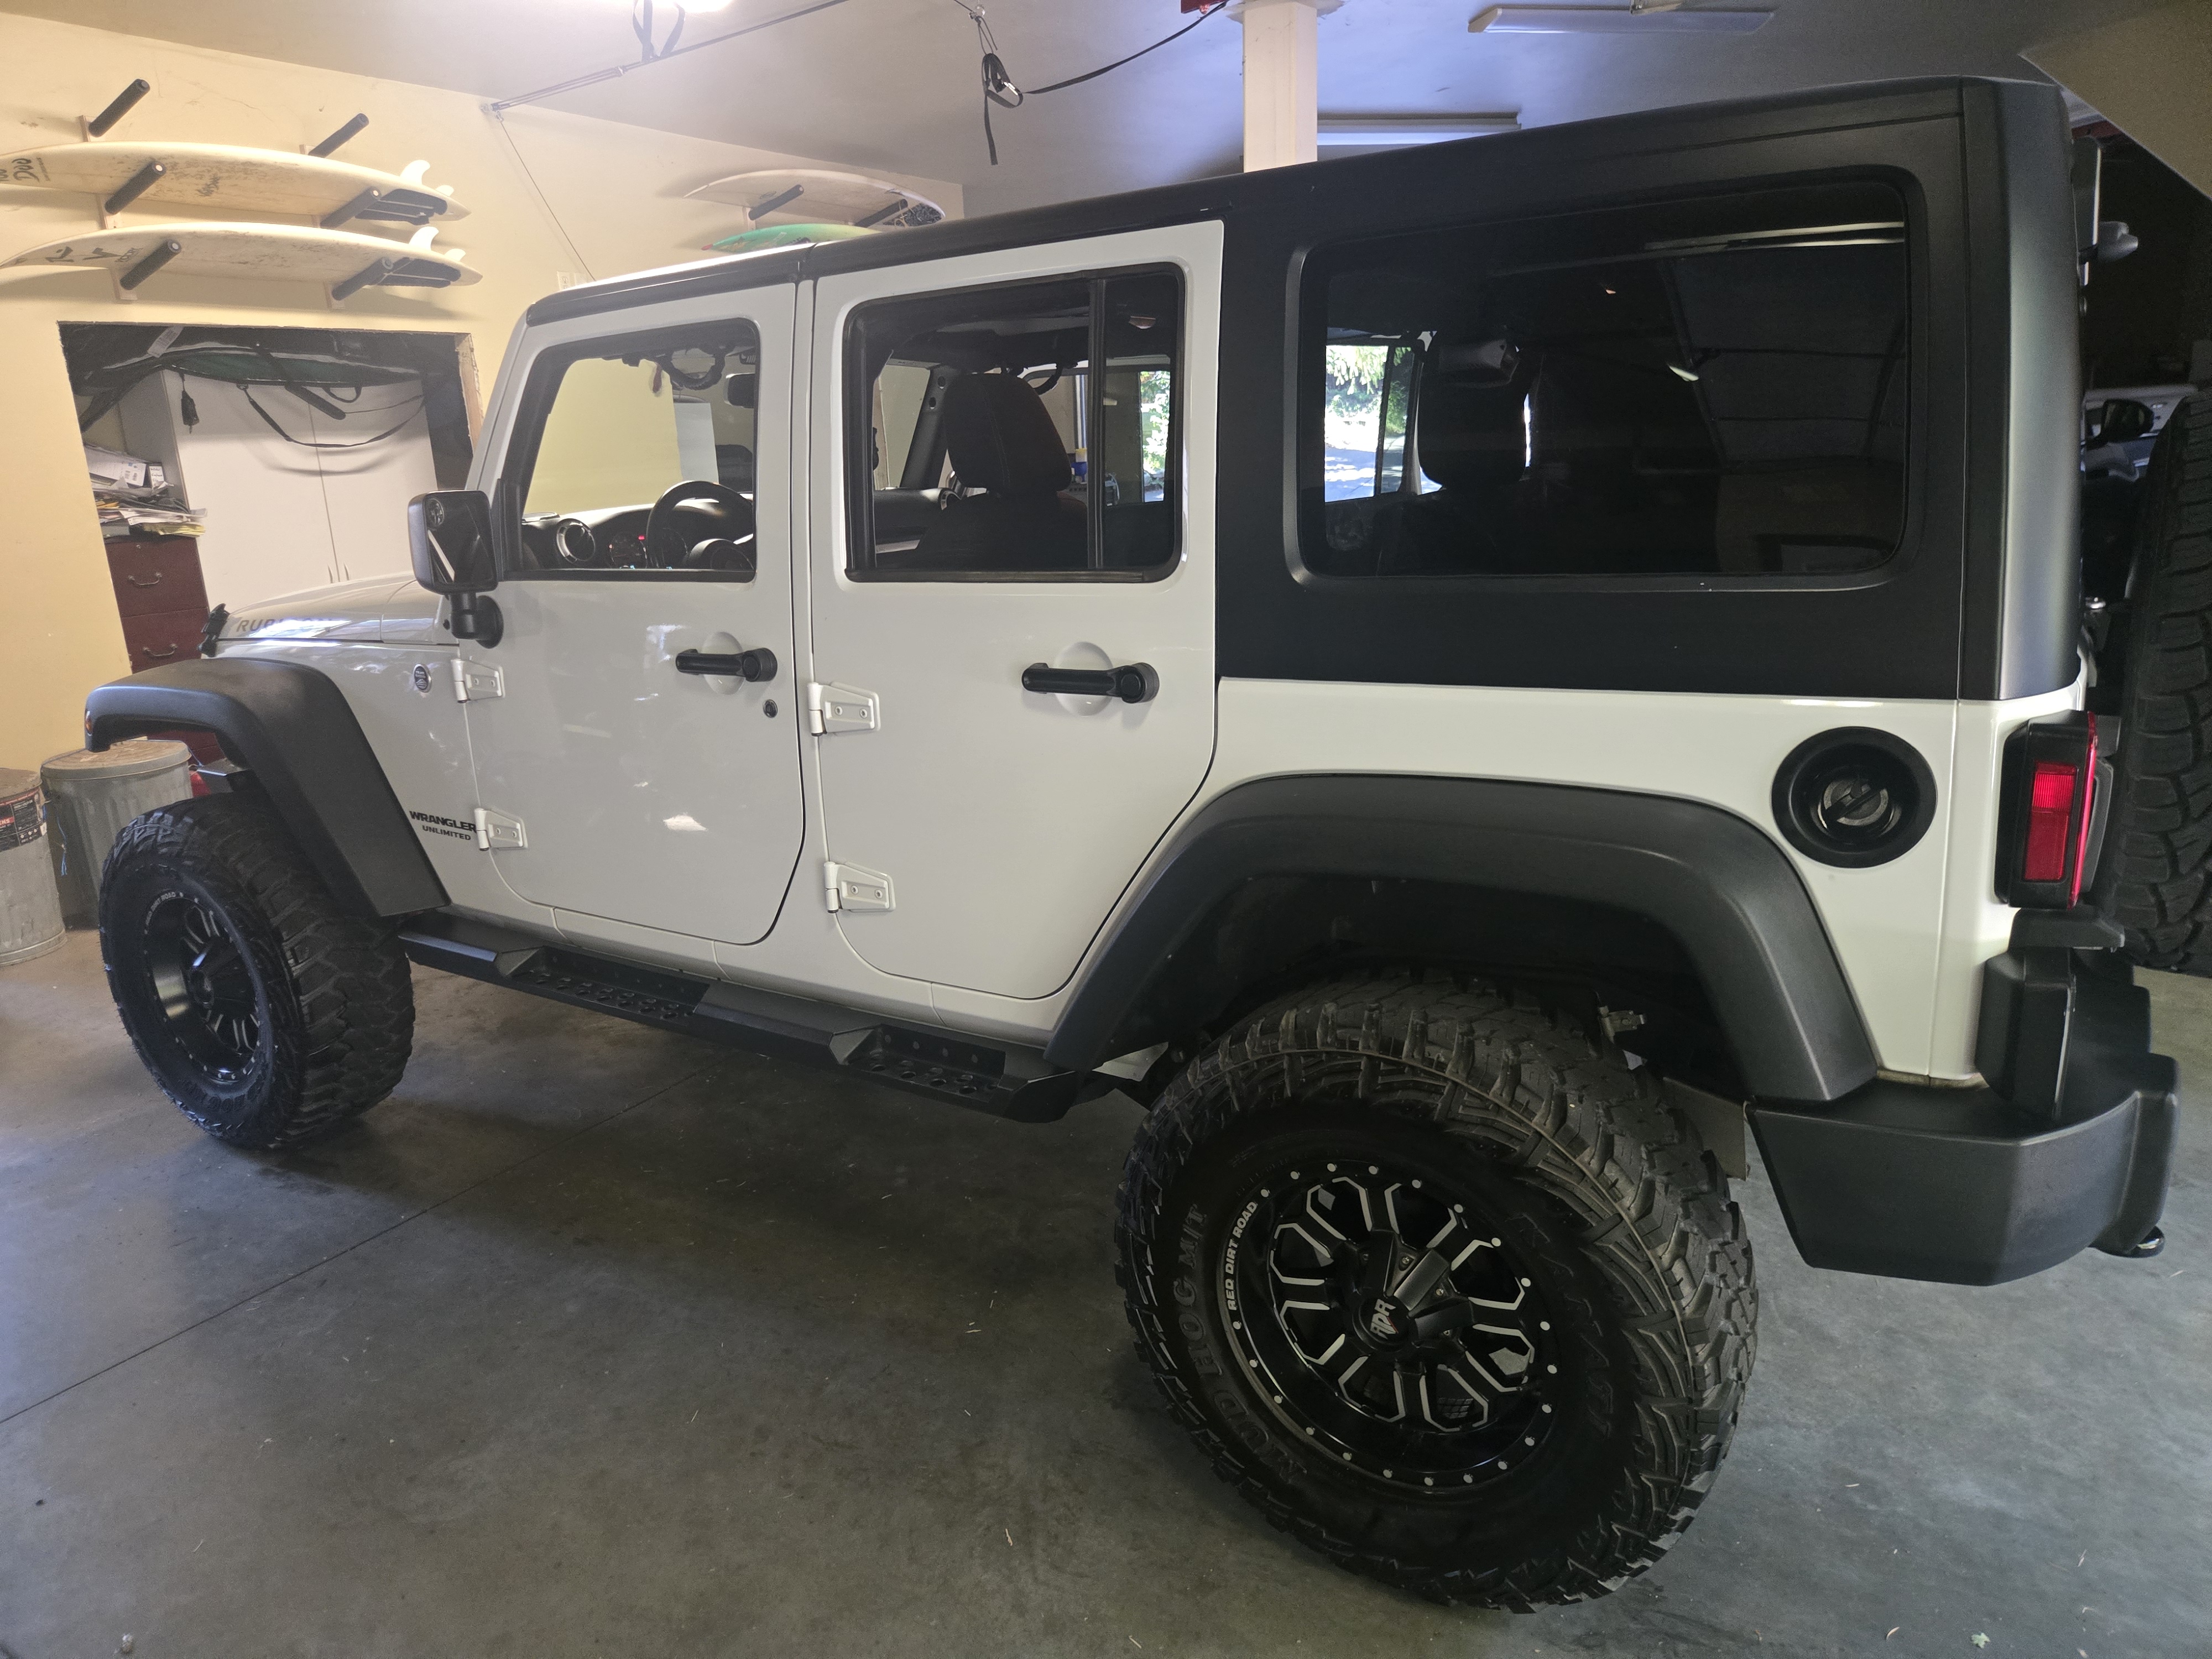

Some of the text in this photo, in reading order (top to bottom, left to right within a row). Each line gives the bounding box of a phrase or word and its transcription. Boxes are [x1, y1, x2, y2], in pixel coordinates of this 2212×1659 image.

[409, 810, 477, 833] WRANGLER
[422, 825, 471, 840] UNLIMITED
[1178, 1203, 1207, 1269] M/T
[1225, 1202, 1258, 1311] RED DIRT ROAD
[1173, 1275, 1223, 1377] HOG
